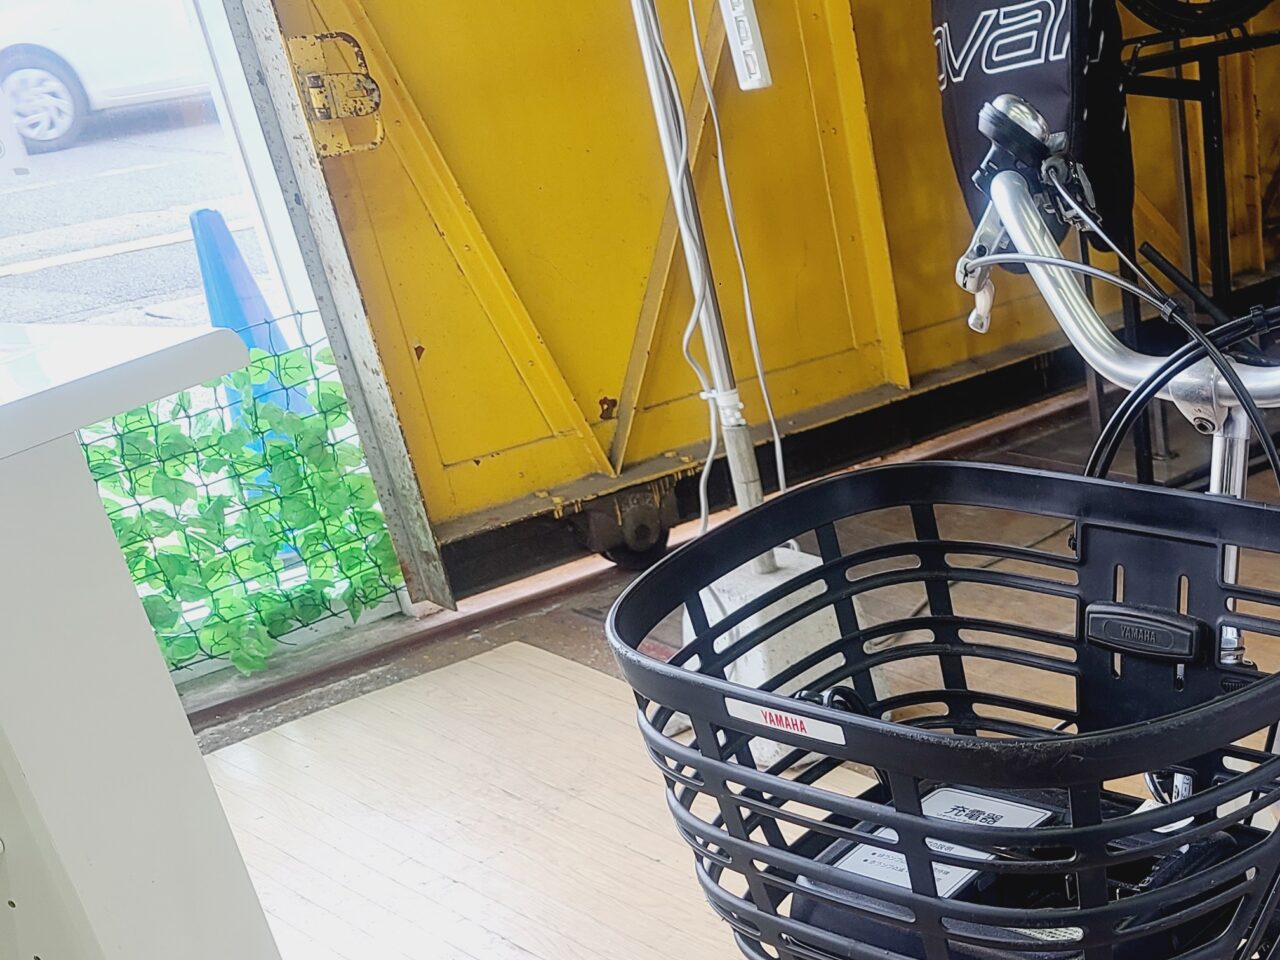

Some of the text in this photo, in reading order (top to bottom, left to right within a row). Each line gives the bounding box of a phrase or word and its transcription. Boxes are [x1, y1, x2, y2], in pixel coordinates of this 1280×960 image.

[1120, 624, 1156, 644] YAMAHA
[760, 709, 808, 734] YAMAHA
[944, 804, 1004, 825] 充電器
